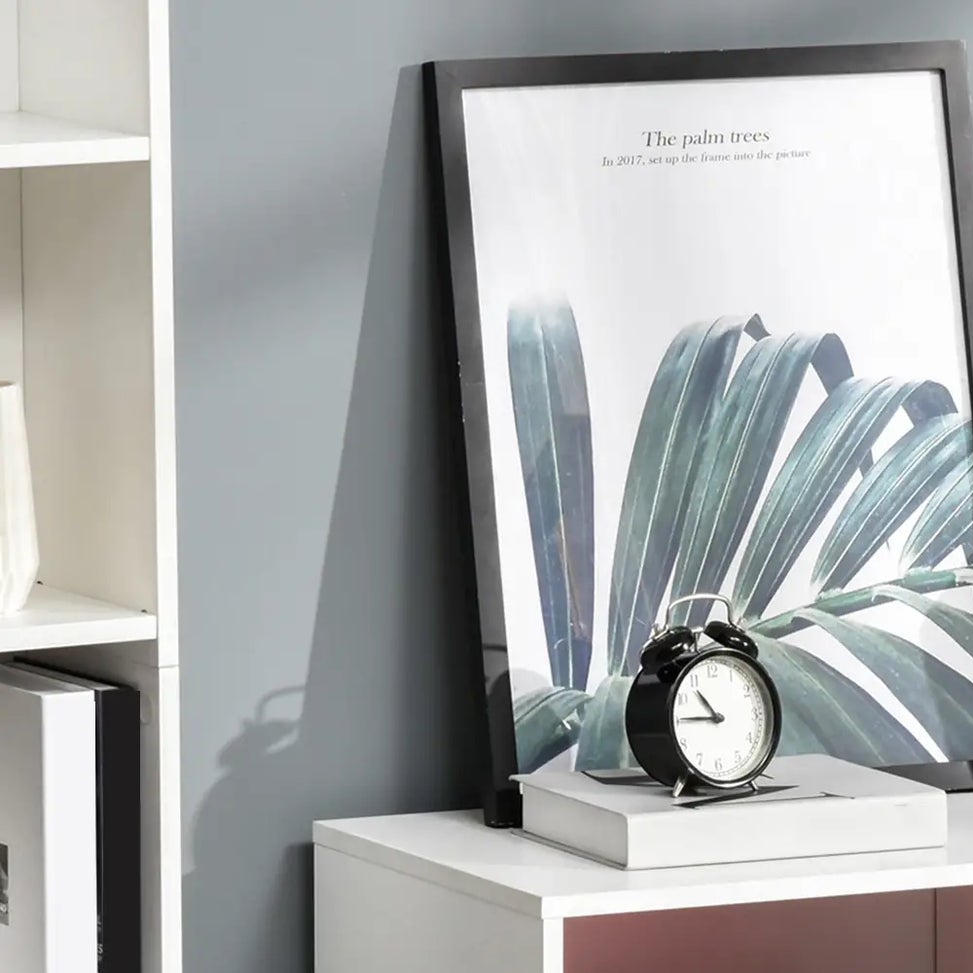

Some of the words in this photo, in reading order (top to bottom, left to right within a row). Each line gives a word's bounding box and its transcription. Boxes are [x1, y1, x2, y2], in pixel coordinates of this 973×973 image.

[641, 130, 677, 148] The
[682, 129, 724, 149] palm
[730, 131, 770, 143] trees
[602, 156, 613, 167] In
[617, 154, 646, 166] 2017,
[648, 155, 662, 164] set
[665, 156, 679, 166] up
[681, 153, 697, 163] the
[701, 151, 730, 162] frame
[733, 151, 754, 161] into
[756, 149, 773, 160] the
[775, 149, 811, 161] picture
[706, 664, 719, 678] 12
[729, 669, 734, 682] 1
[689, 673, 699, 688] 11
[743, 684, 751, 698] 2
[752, 708, 759, 721] 3
[696, 752, 703, 766] 7
[734, 750, 742, 763] 5
[714, 758, 723, 771] 6
